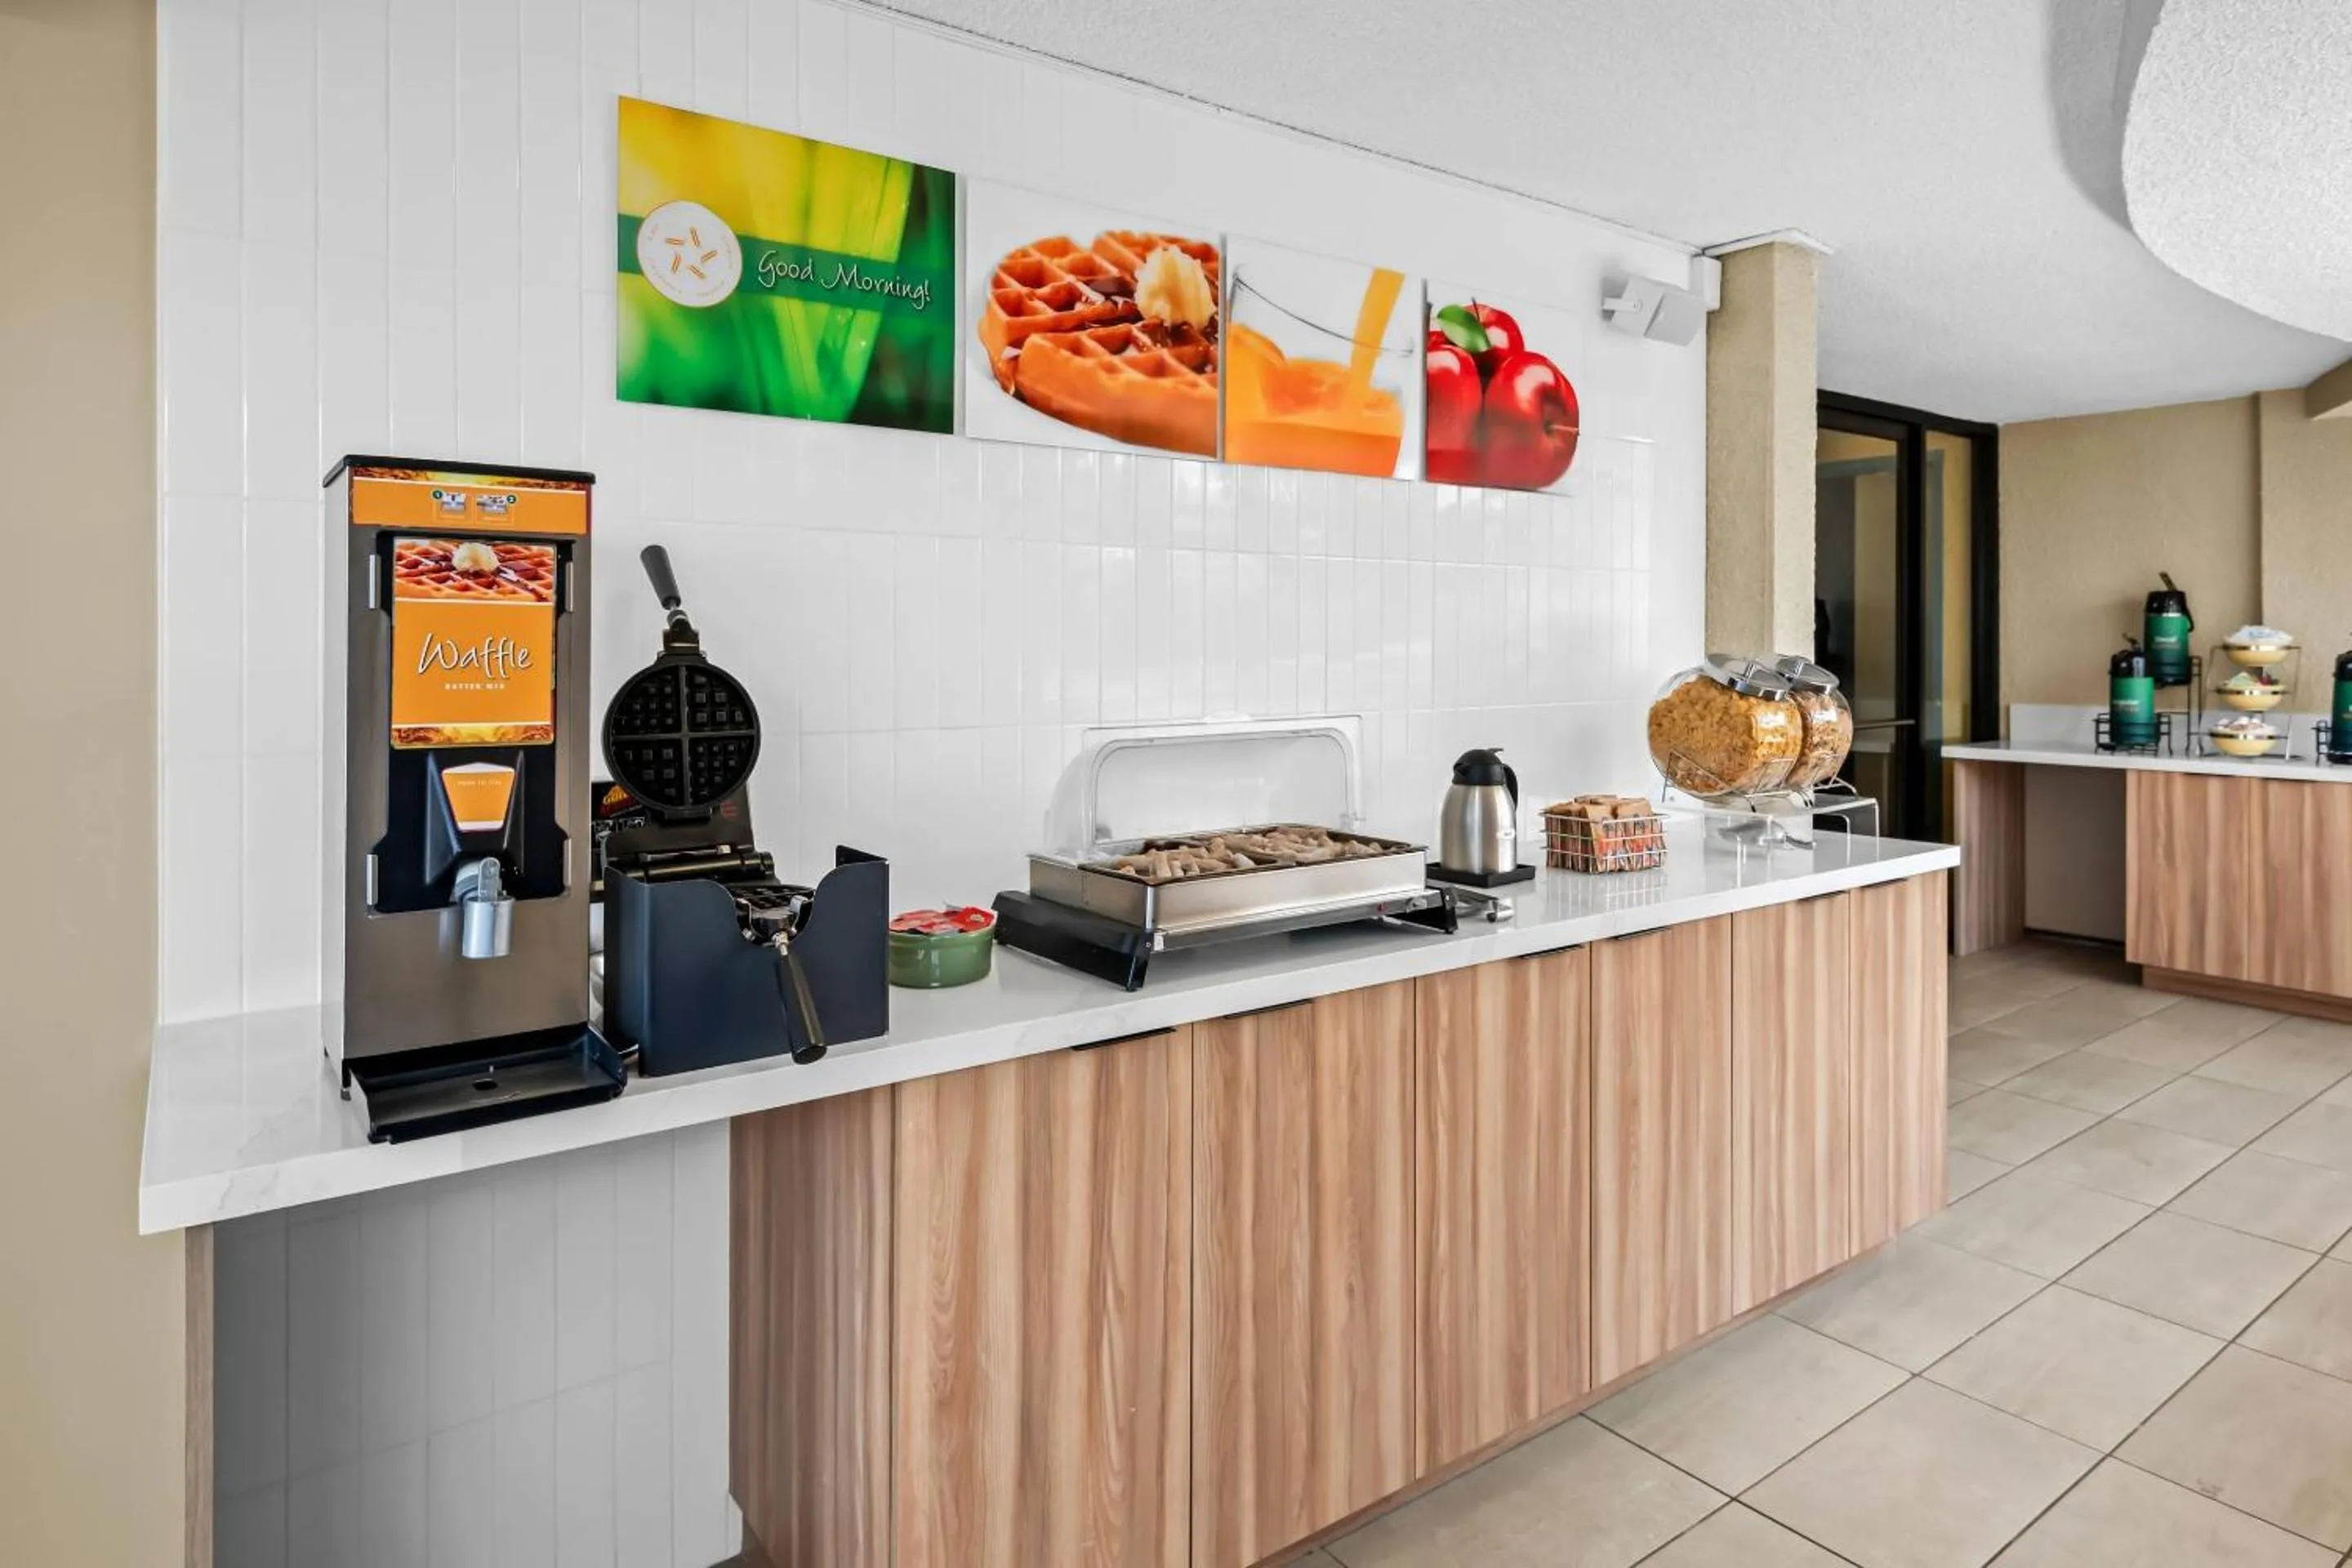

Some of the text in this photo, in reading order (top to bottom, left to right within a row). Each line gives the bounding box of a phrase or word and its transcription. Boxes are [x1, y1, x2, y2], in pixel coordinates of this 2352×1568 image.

[758, 250, 814, 287] Good
[820, 262, 931, 310] Morning!
[417, 632, 533, 679] Waffle
